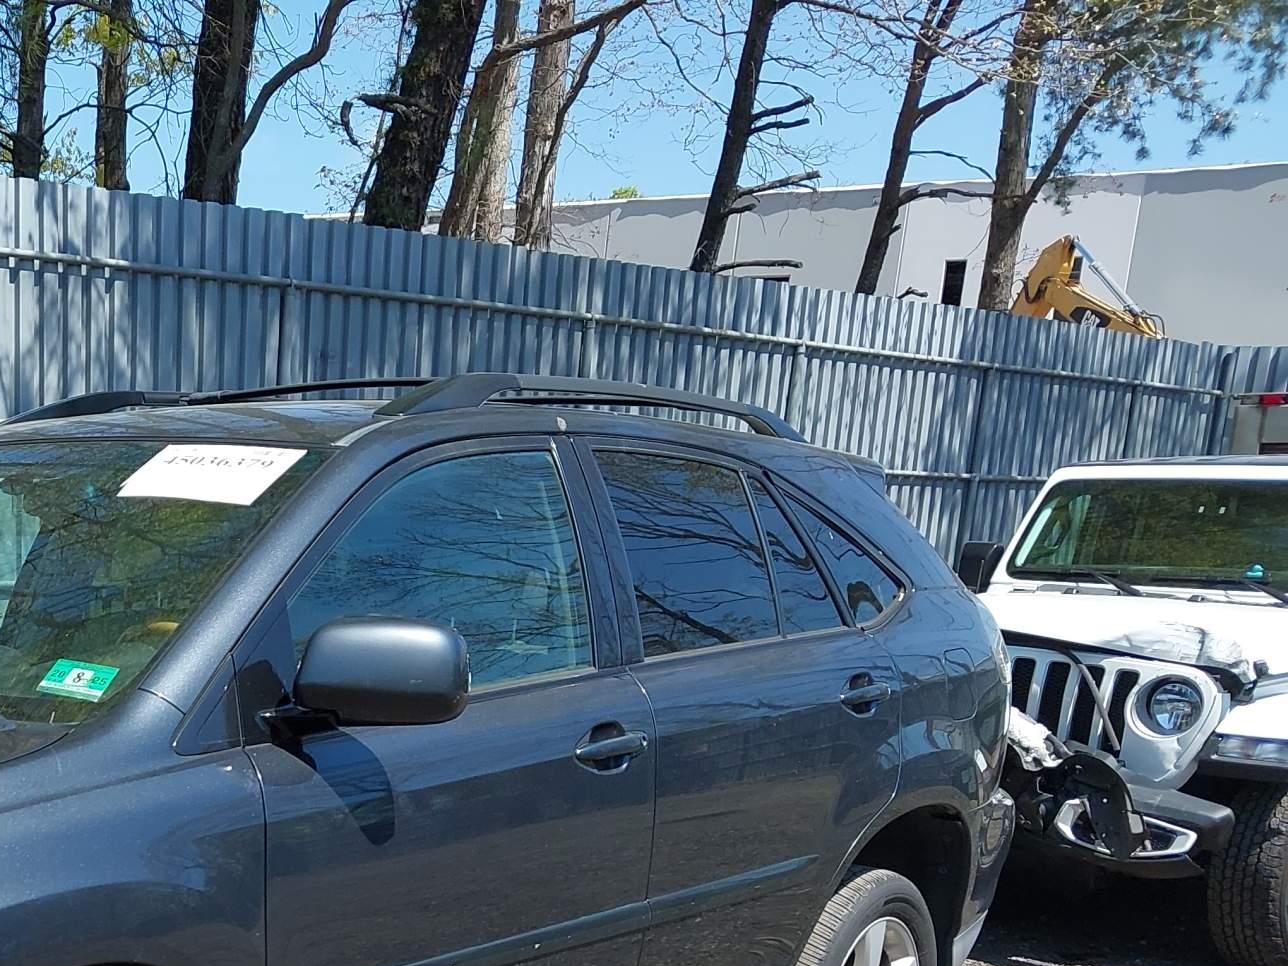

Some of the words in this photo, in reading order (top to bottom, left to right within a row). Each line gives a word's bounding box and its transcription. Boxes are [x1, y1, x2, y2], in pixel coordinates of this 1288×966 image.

[1082, 310, 1101, 327] CAT
[163, 455, 275, 469] 45036379
[51, 669, 66, 678] 20
[73, 671, 85, 684] 8
